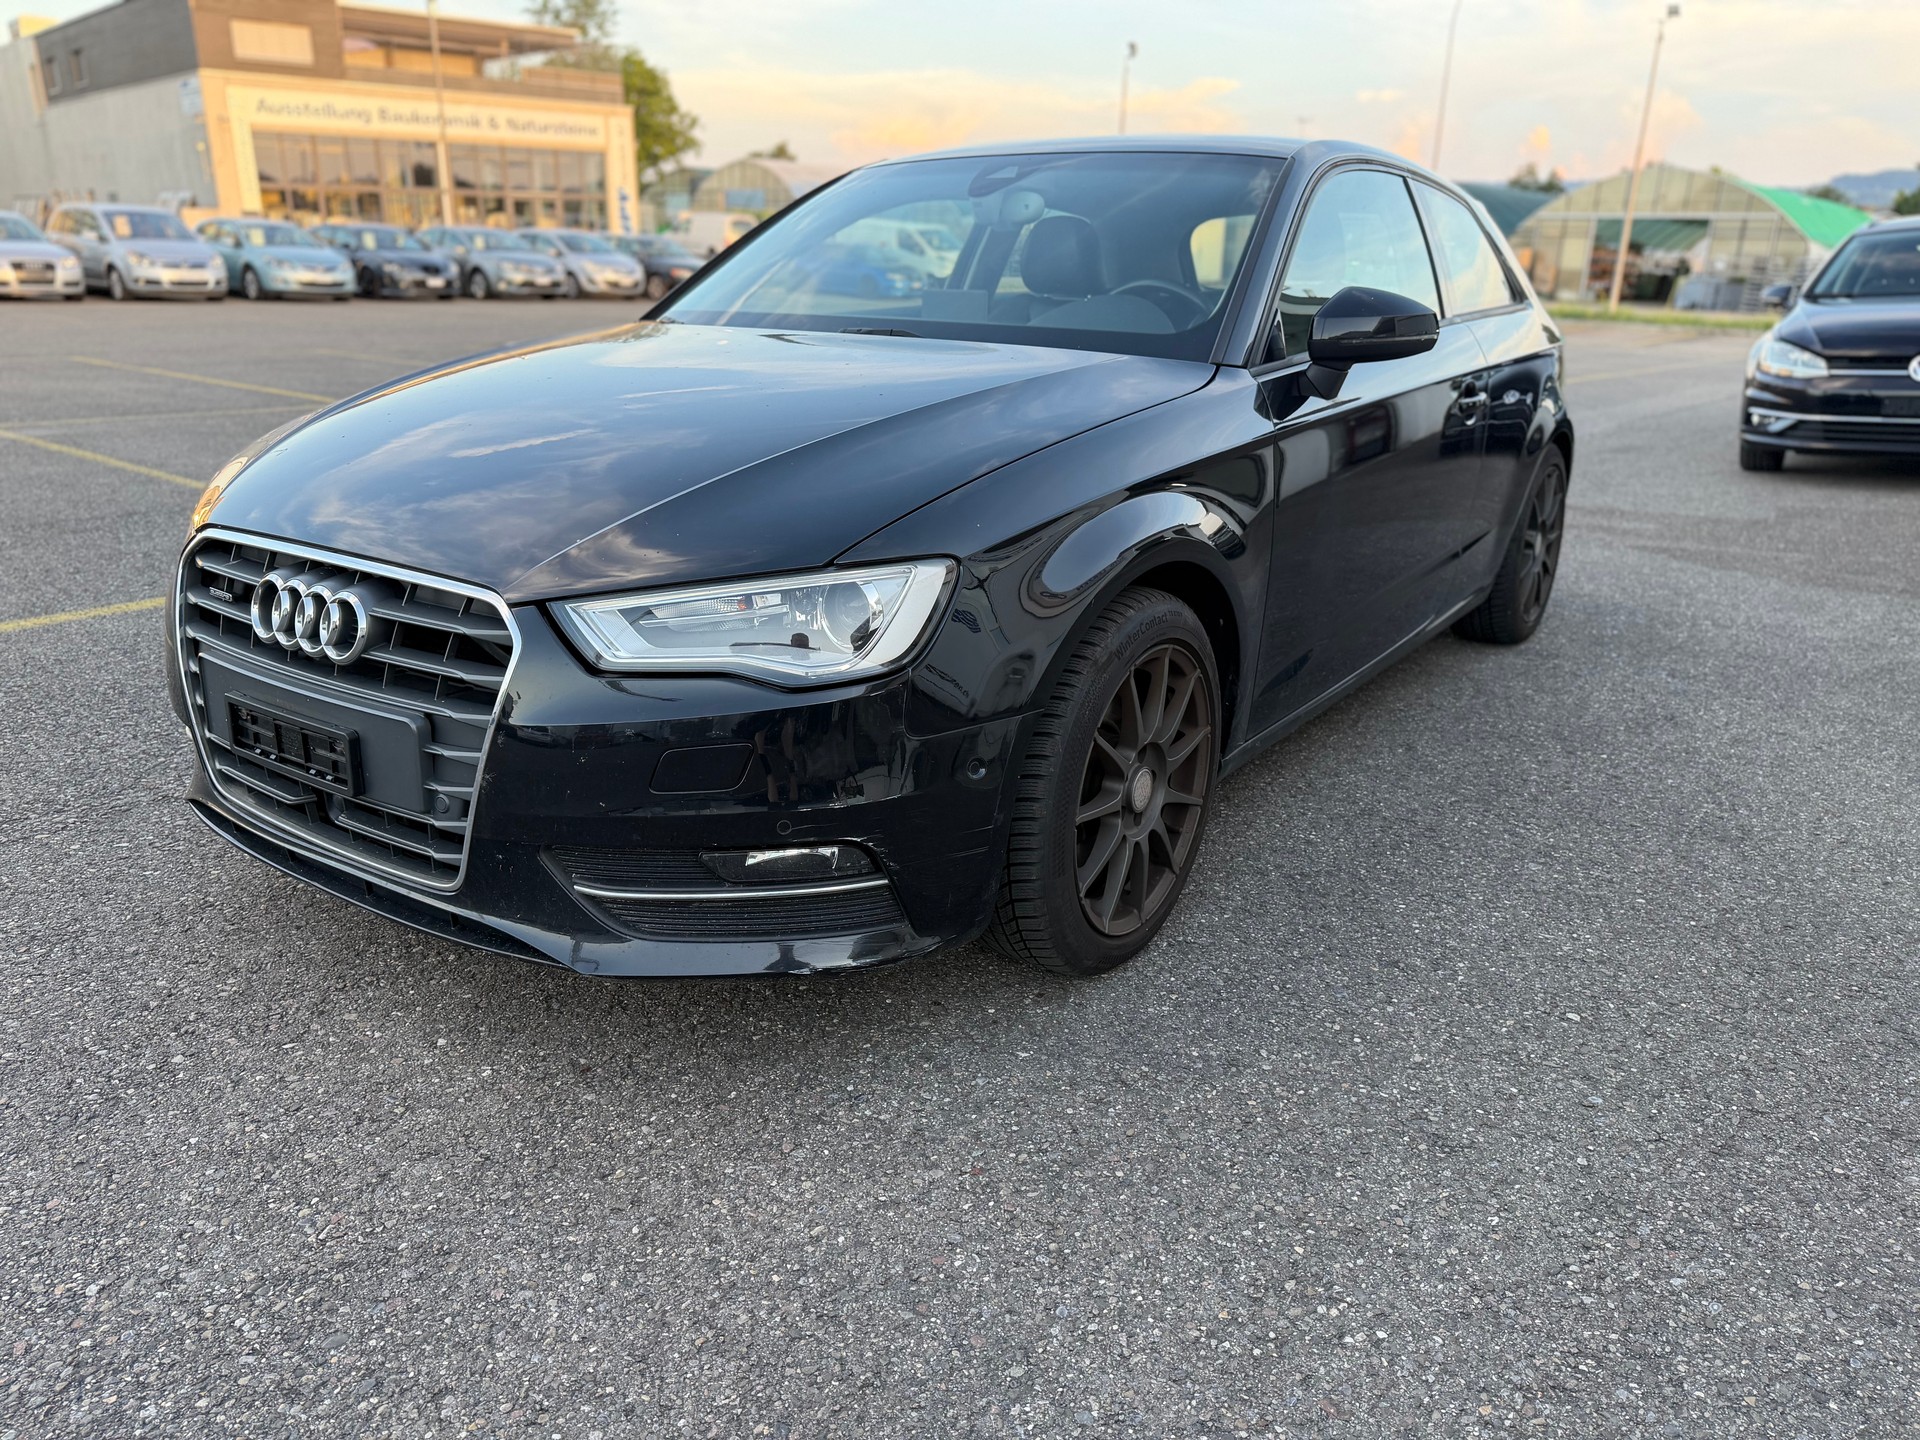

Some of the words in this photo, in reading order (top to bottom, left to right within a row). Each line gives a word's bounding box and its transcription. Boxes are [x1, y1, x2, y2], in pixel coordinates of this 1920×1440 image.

[256, 97, 373, 125] Ausstellung
[488, 114, 500, 131] &
[504, 117, 599, 137] Natursteine
[1113, 611, 1169, 660] WinterContact
